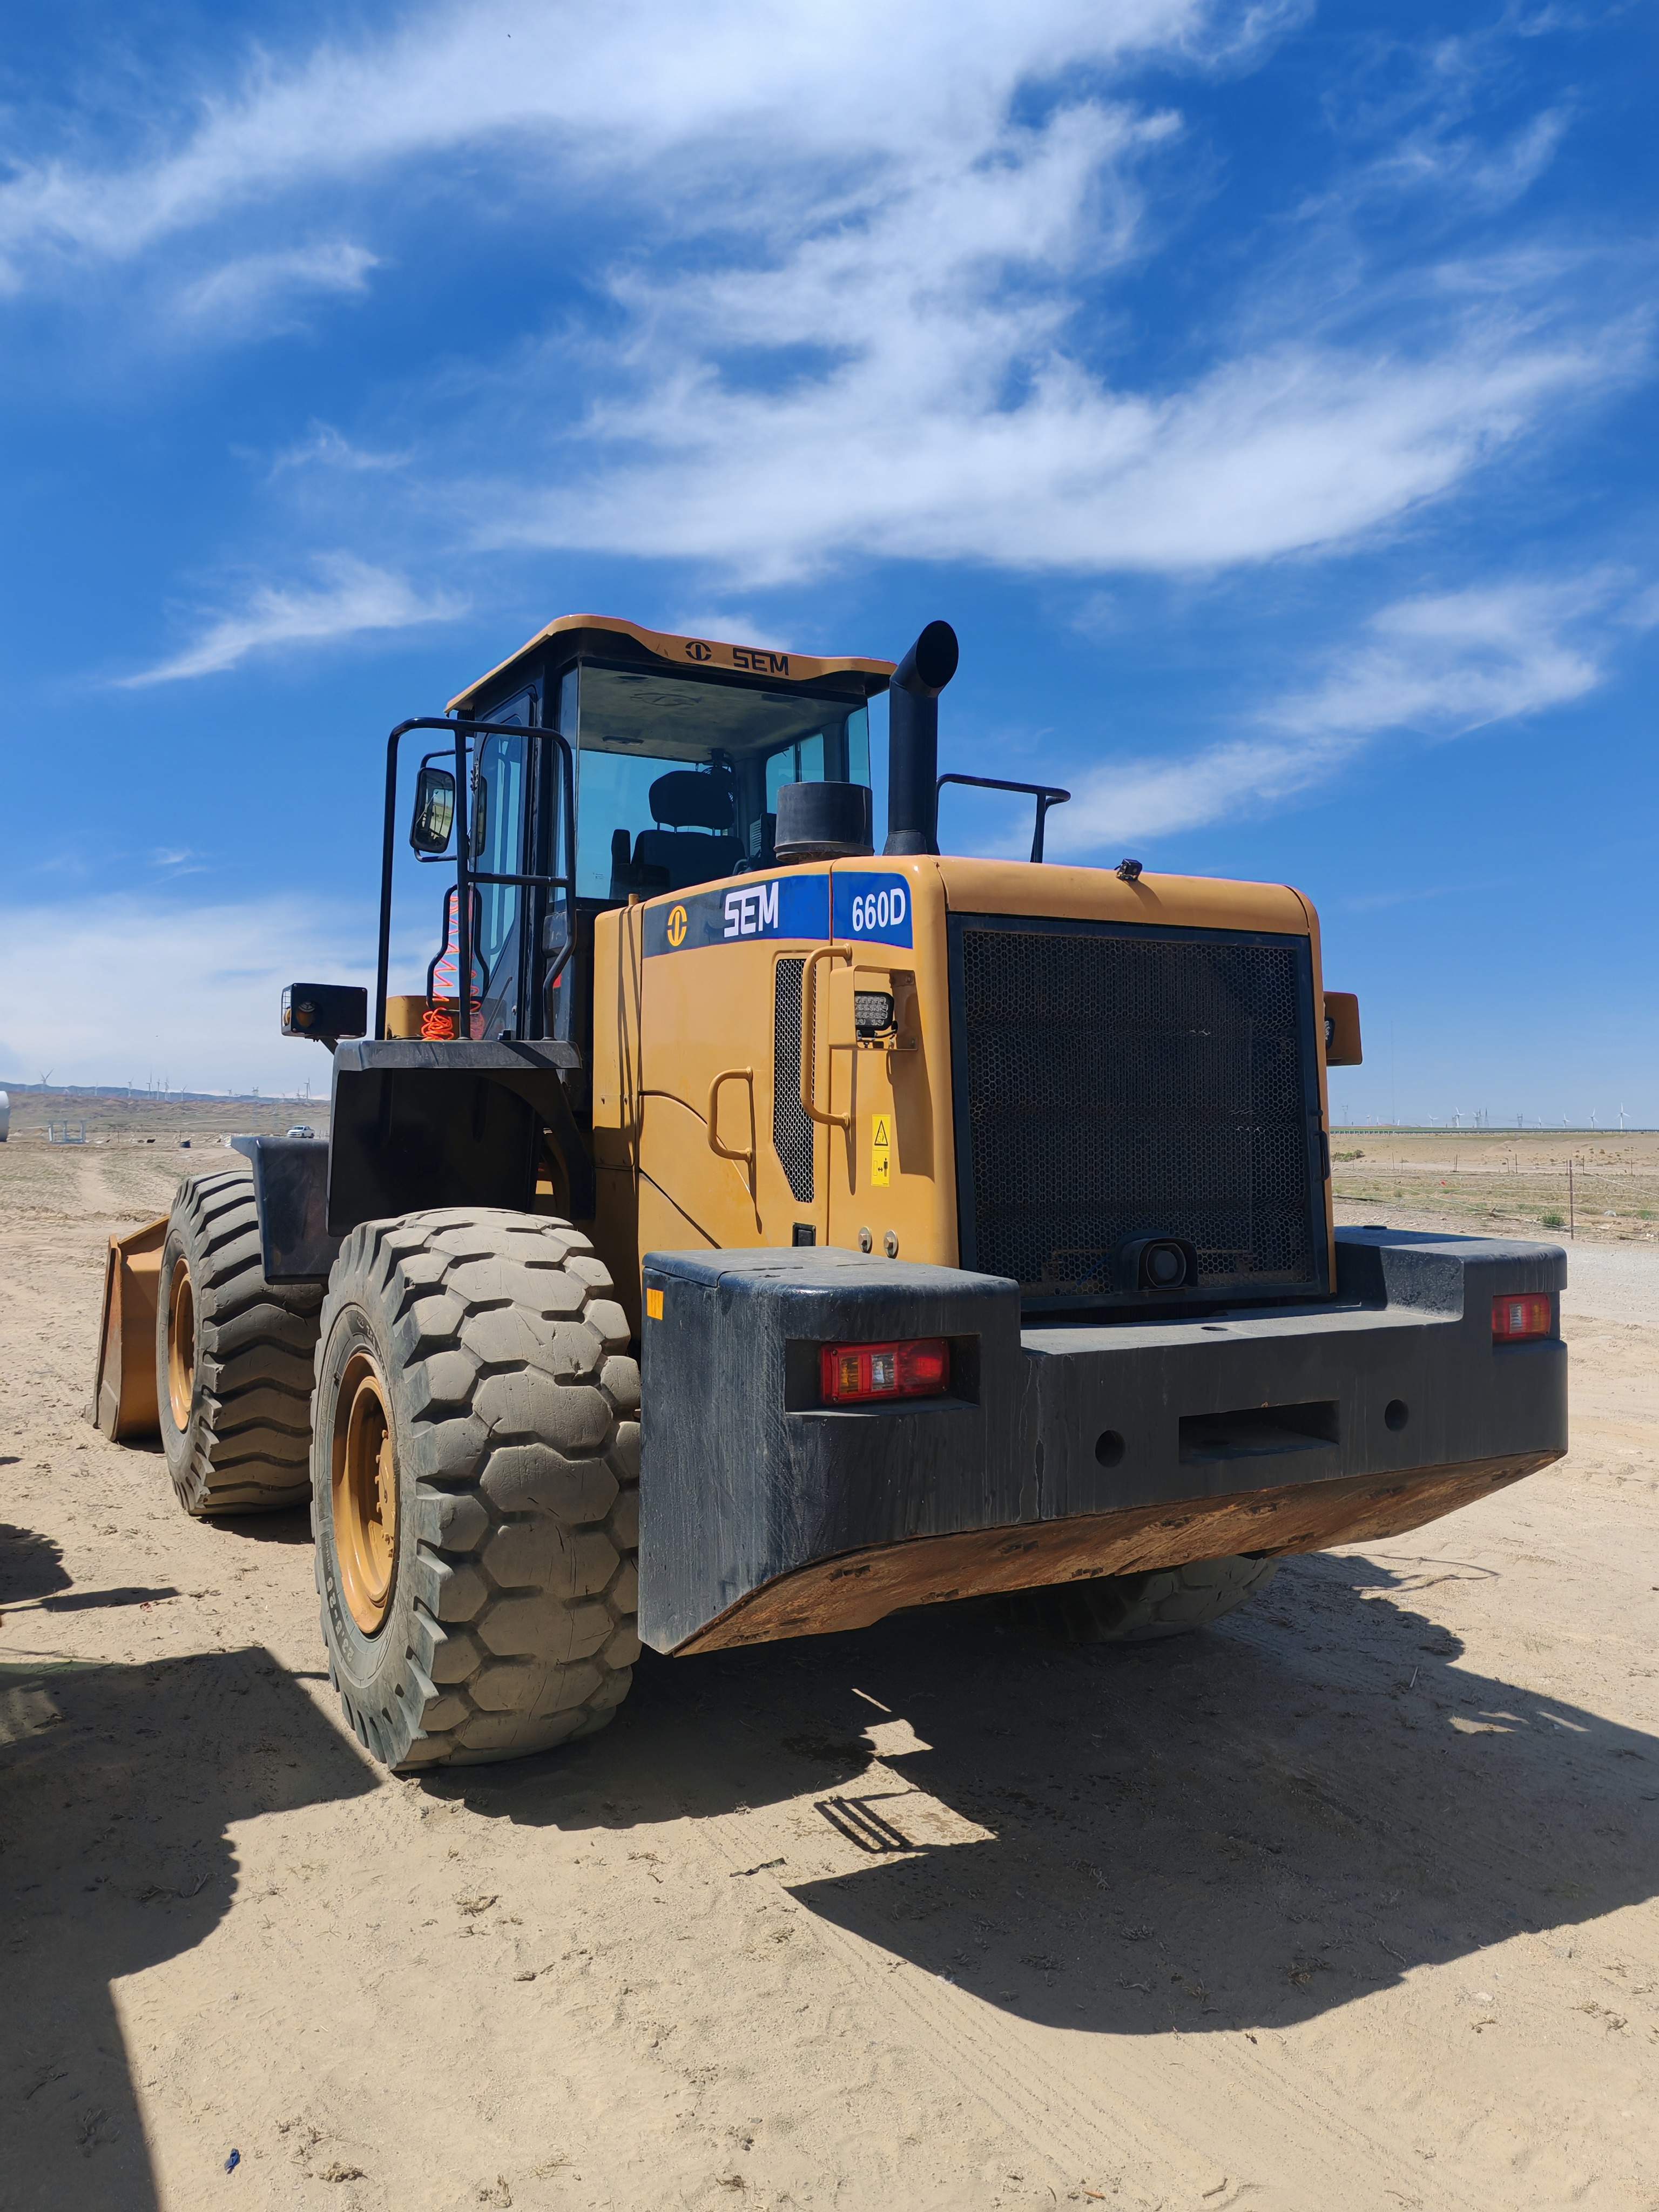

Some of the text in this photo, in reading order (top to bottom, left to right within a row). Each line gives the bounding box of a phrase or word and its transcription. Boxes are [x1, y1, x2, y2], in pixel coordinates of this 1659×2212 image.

[733, 648, 789, 676] SEM
[724, 881, 779, 938] SEM
[852, 887, 906, 932] 660D
